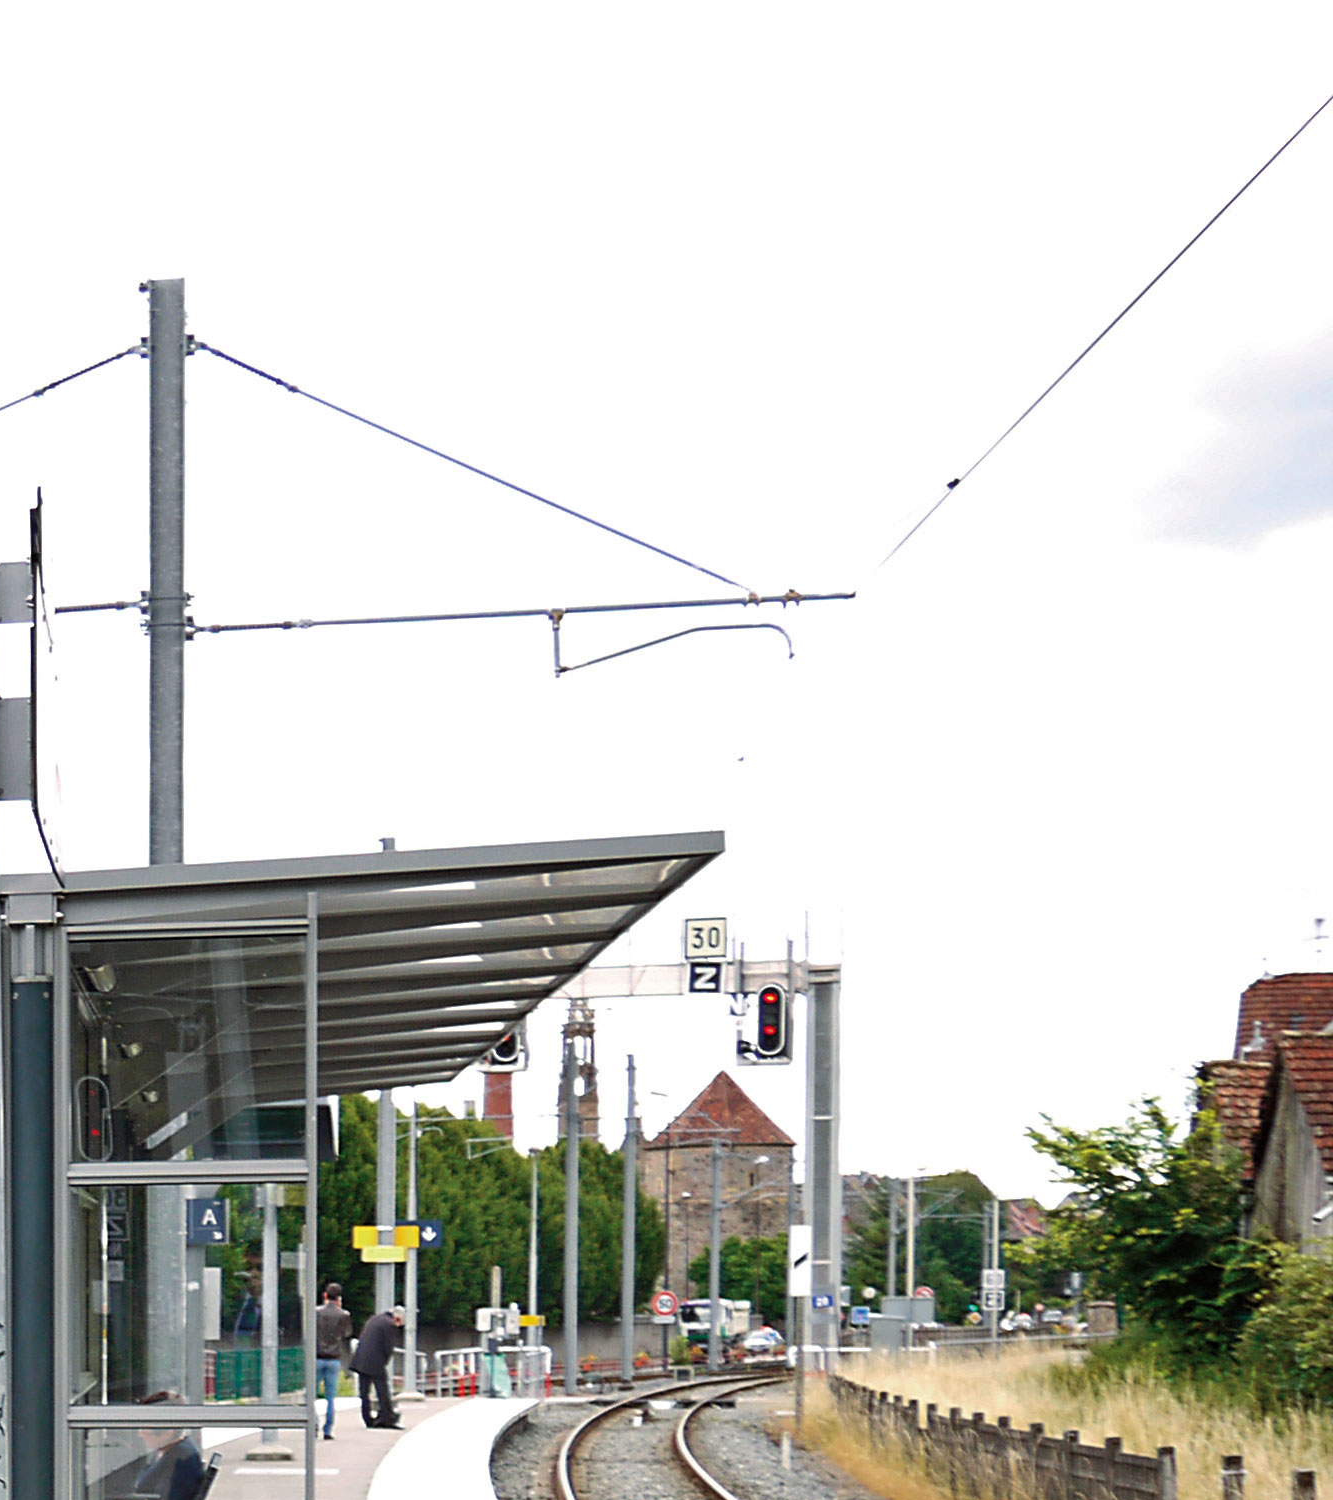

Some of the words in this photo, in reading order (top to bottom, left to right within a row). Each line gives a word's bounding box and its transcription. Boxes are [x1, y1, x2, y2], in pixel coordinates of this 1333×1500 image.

[691, 926, 720, 949] 30
[693, 966, 717, 989] Z
[201, 1208, 217, 1226] A
